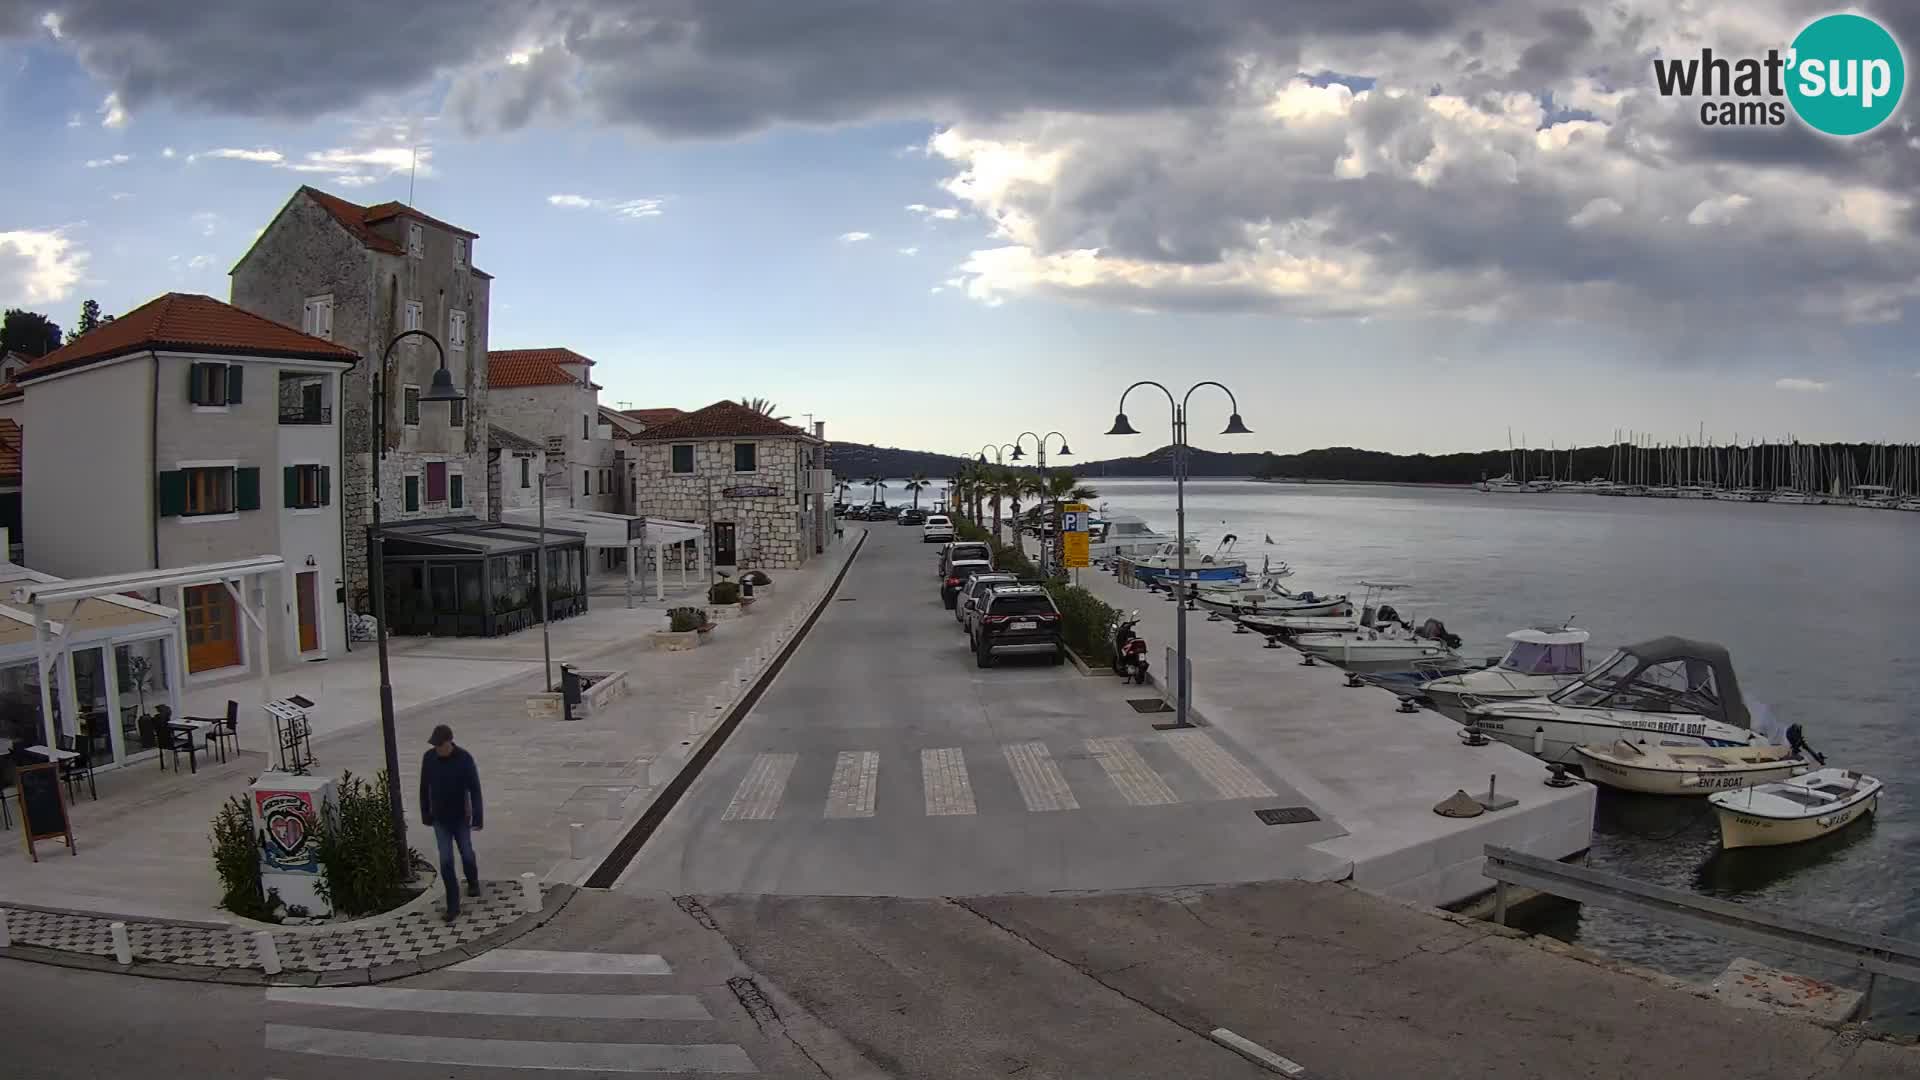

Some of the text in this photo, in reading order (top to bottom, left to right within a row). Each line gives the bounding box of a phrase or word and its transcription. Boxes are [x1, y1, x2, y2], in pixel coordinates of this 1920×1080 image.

[1065, 514, 1076, 531] P
[1658, 722, 1680, 732] RENT
[1680, 723, 1686, 732] A
[1687, 723, 1707, 735] BOAT
[1698, 777, 1744, 788] ENT A BOAT
